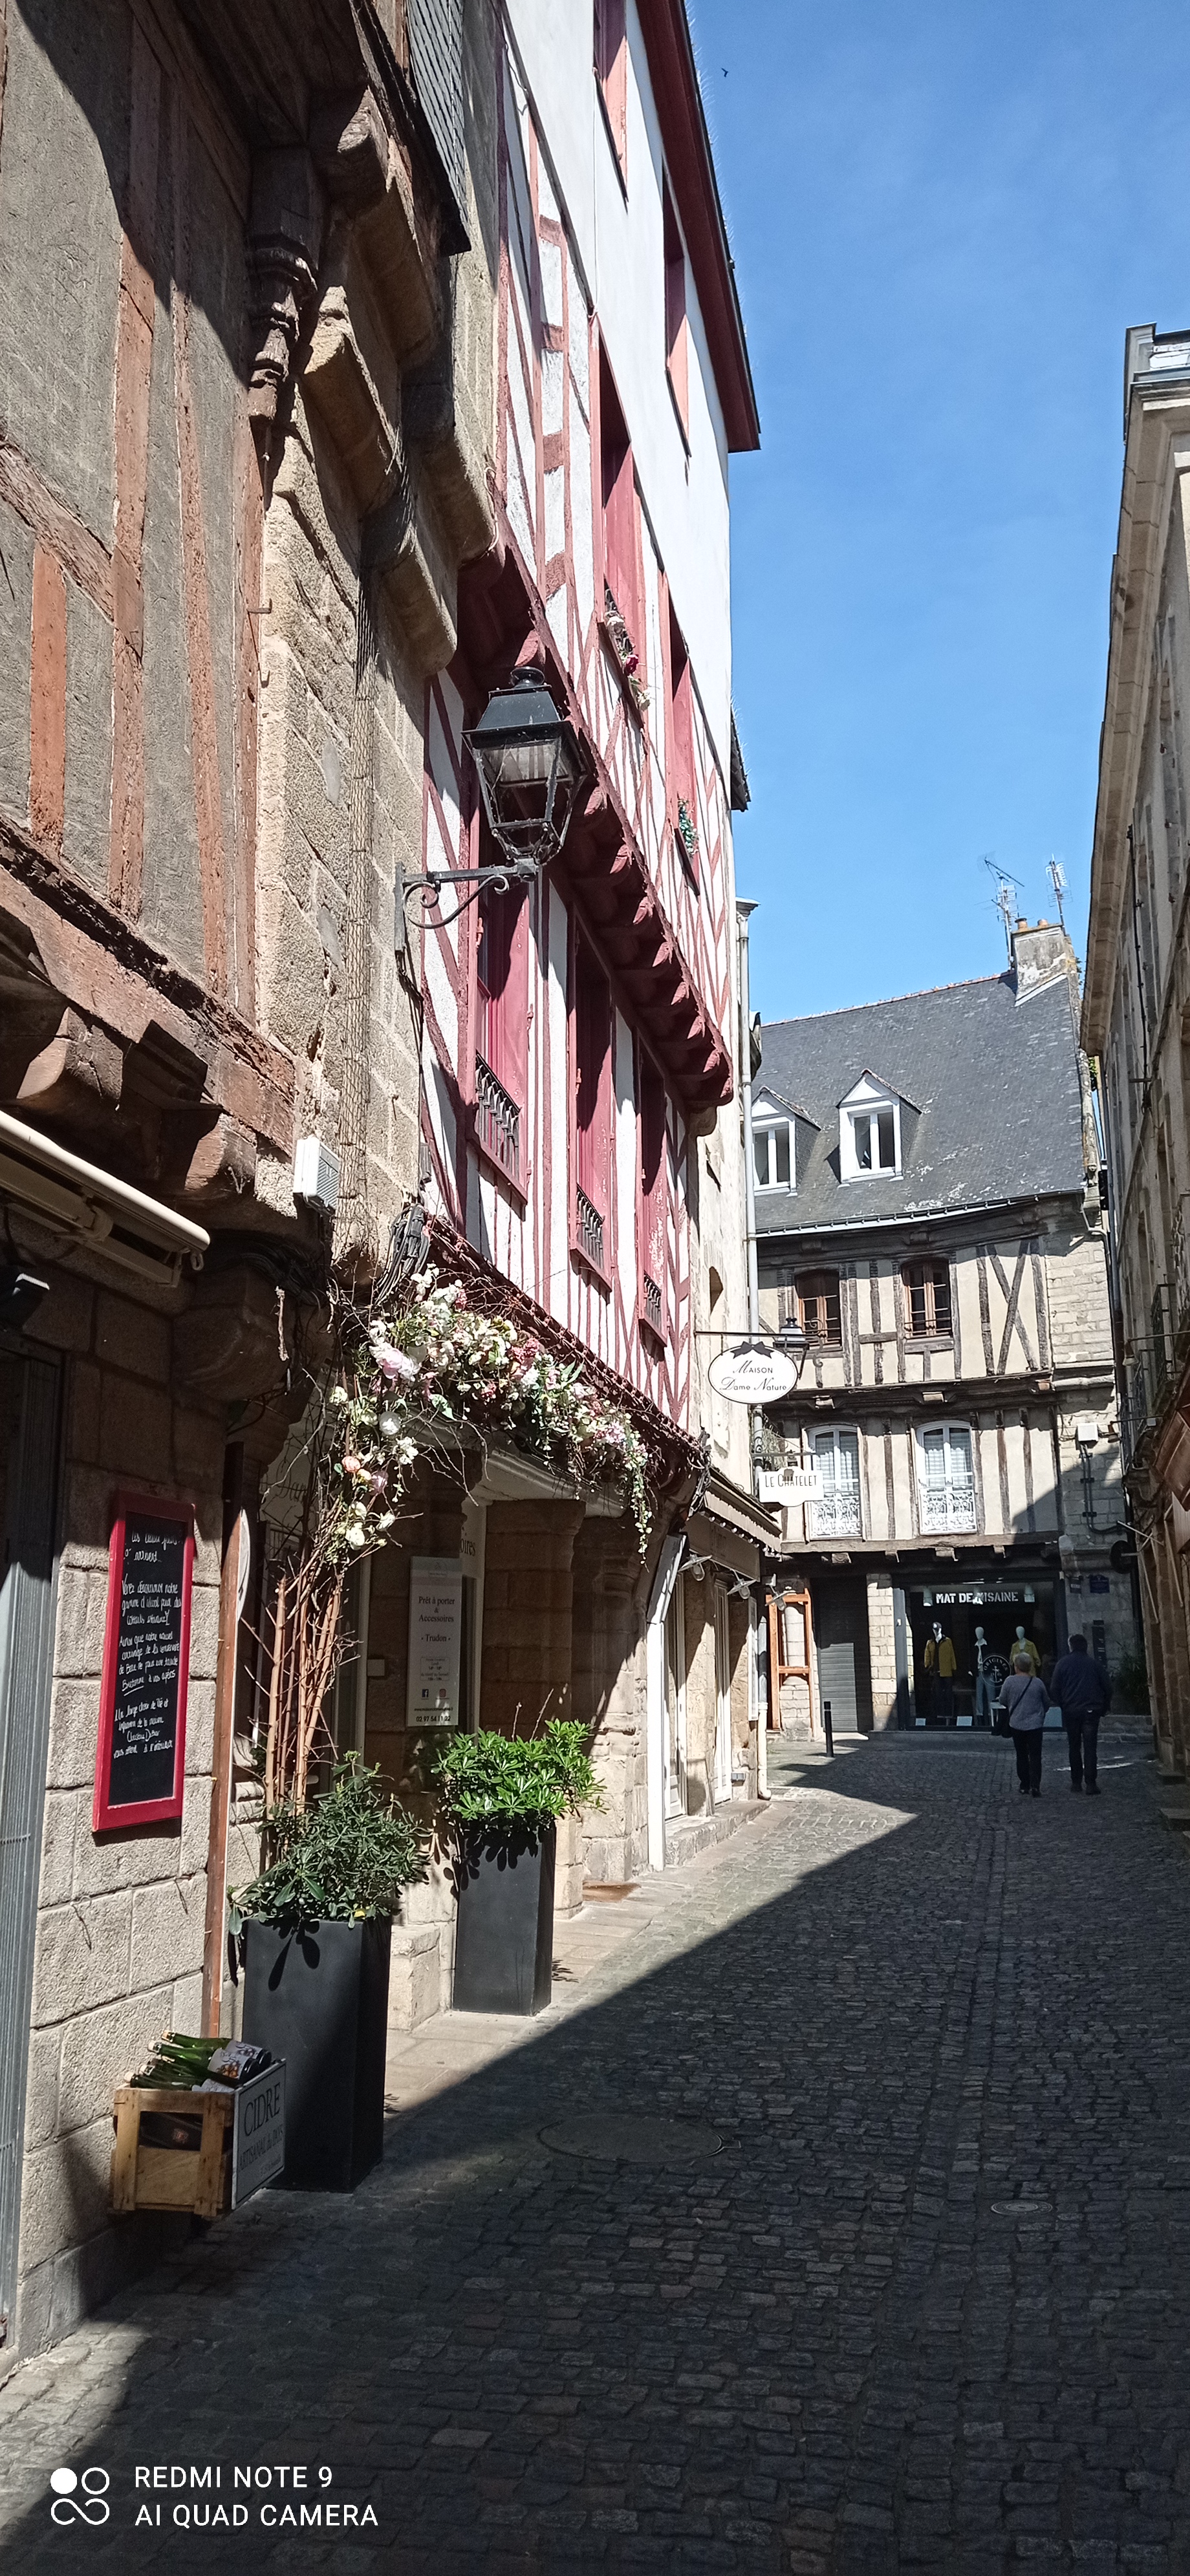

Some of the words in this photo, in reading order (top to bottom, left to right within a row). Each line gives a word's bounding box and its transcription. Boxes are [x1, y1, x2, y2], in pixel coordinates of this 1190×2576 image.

[719, 1377, 750, 1390] Dame
[753, 1377, 786, 1390] Nature
[418, 1596, 431, 1604] Prêt
[936, 1593, 956, 1604] MAT
[958, 1593, 973, 1603] DE
[244, 2081, 281, 2136] CIDRE
